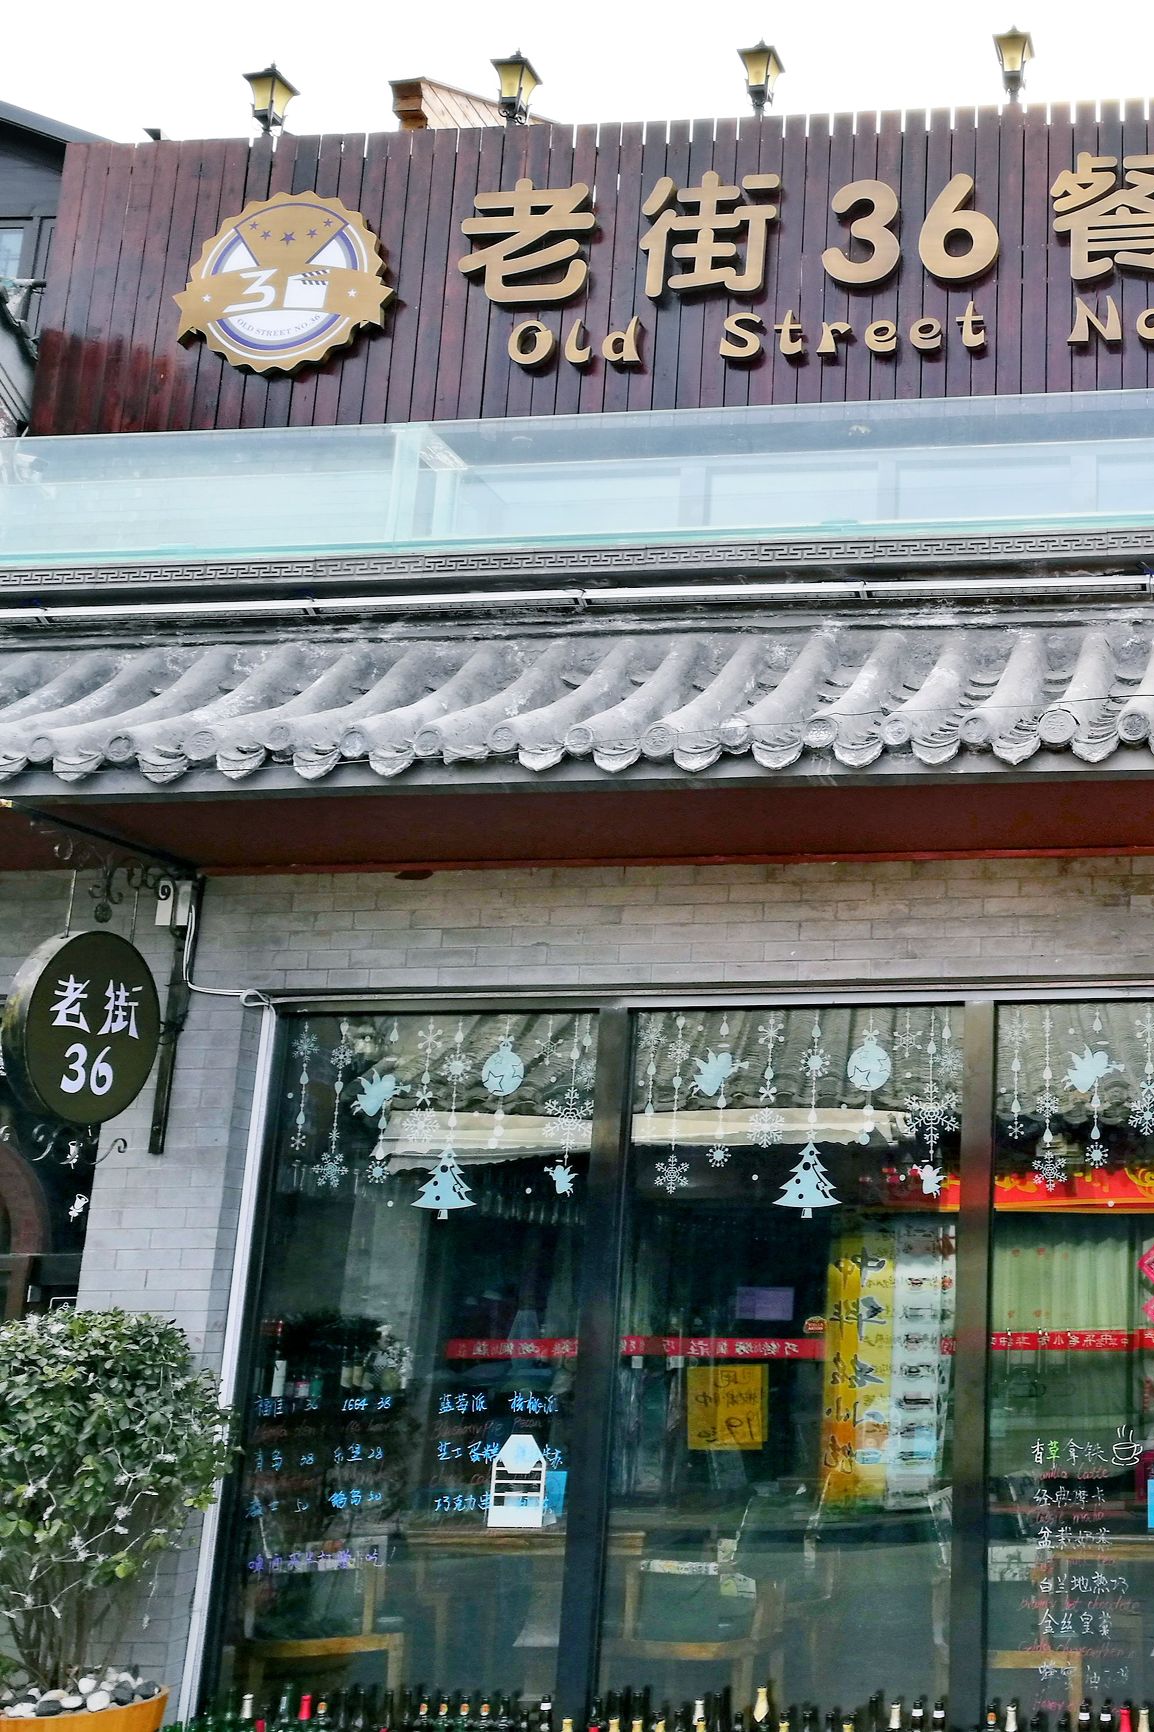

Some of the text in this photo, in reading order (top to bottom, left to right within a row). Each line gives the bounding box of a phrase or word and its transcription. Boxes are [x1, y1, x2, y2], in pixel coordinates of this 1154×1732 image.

[237, 317, 255, 334] OLD
[256, 327, 291, 337] STREET
[507, 315, 643, 367] Old
[719, 300, 987, 361] Street
[49, 974, 144, 1040] 老街
[59, 1042, 114, 1096] 36
[341, 1396, 392, 1412] 1664 38
[438, 1391, 488, 1414] 蓝莓派
[1031, 1438, 1108, 1468] 香草拿铁
[1033, 1486, 1106, 1510] 经典摩卡
[1038, 1608, 1112, 1640] 金丝皇菊
